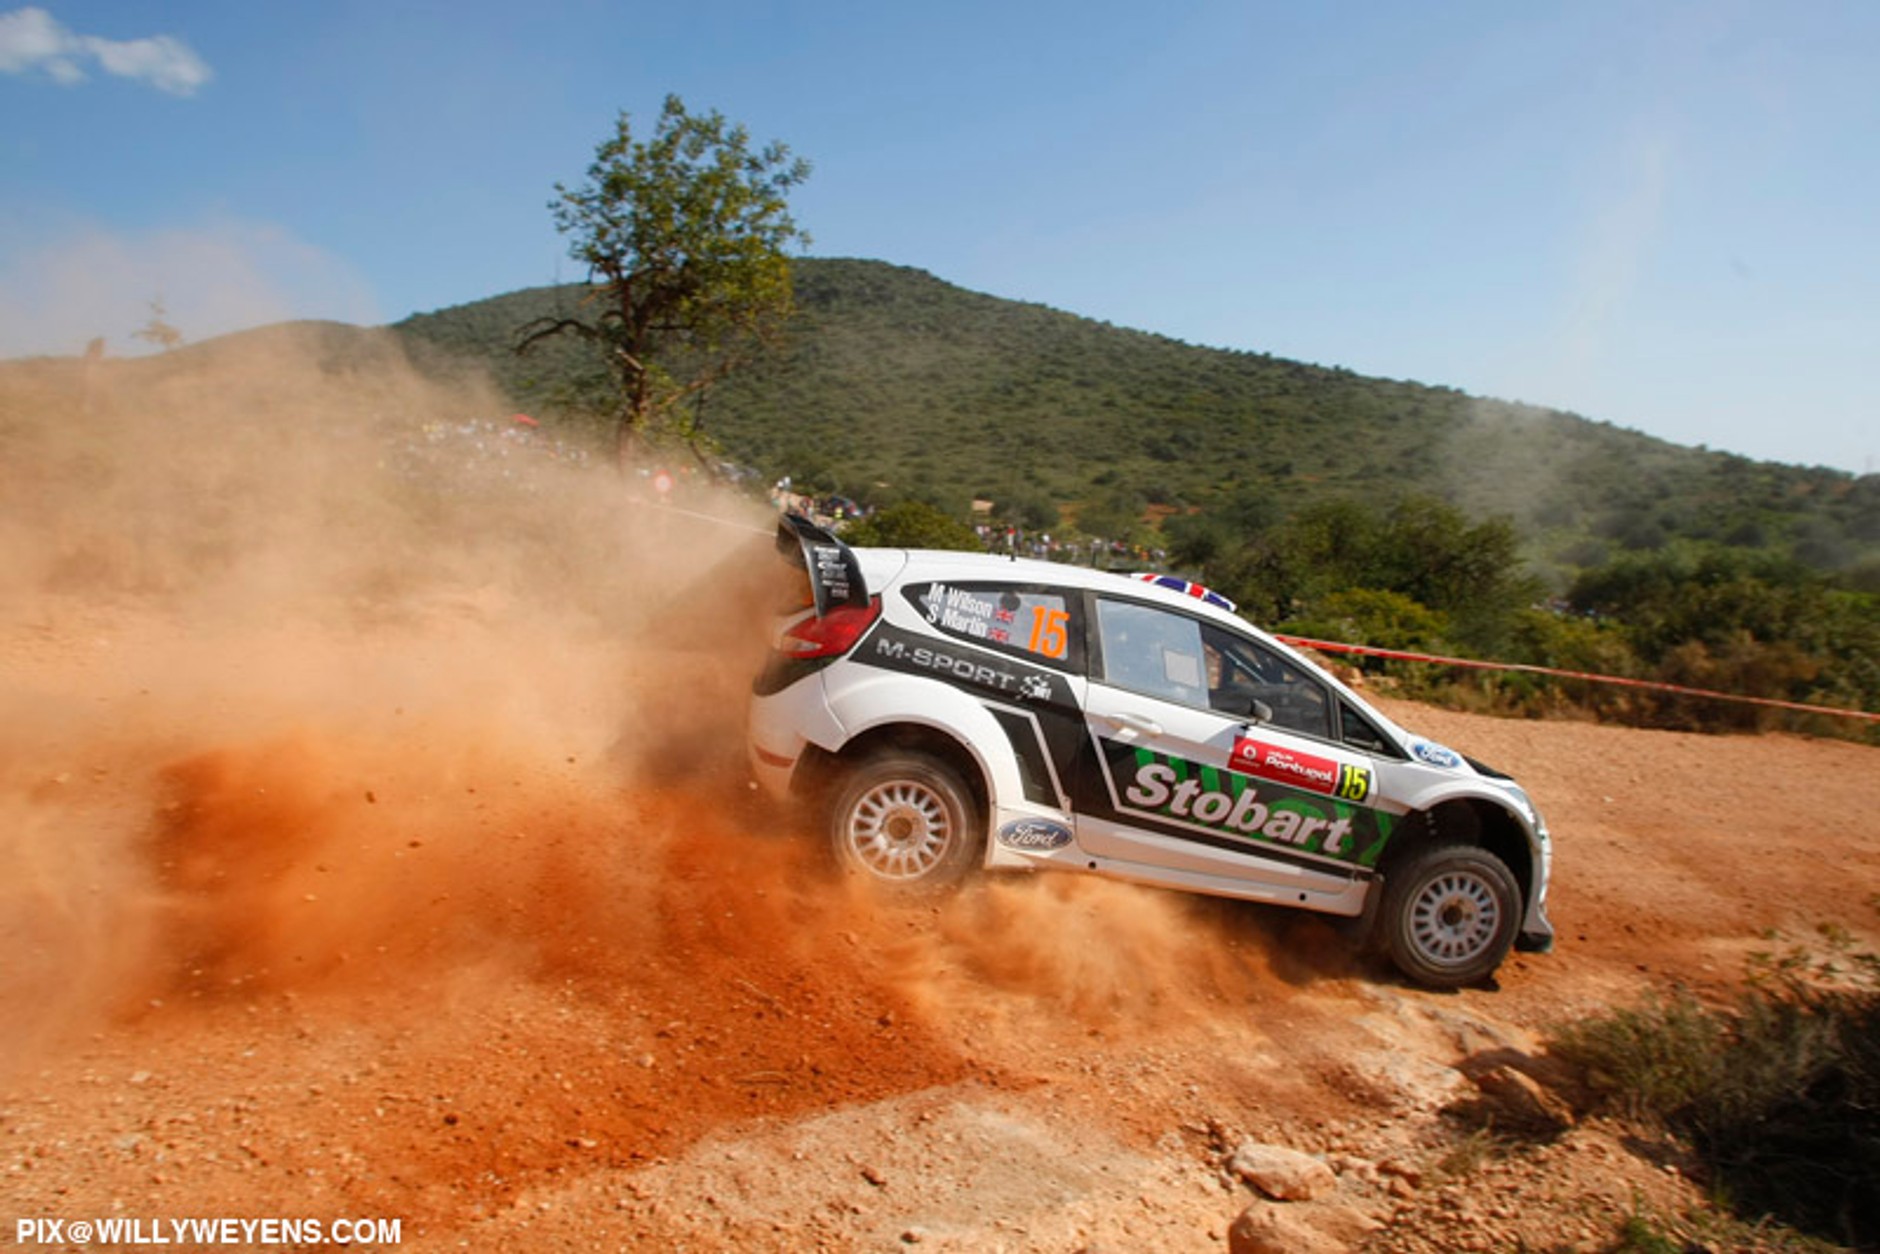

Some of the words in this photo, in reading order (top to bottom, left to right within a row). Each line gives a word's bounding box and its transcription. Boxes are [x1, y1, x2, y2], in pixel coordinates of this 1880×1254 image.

[928, 582, 944, 603] M
[947, 587, 993, 619] Wilson
[926, 603, 939, 624] S
[941, 608, 988, 638] Martin
[1029, 605, 1071, 659] 15
[876, 638, 1015, 690] M-SPORT
[1265, 754, 1334, 782] Portugal
[1340, 763, 1368, 800] 15
[1125, 763, 1353, 854] Stobart
[1008, 823, 1060, 848] Ford
